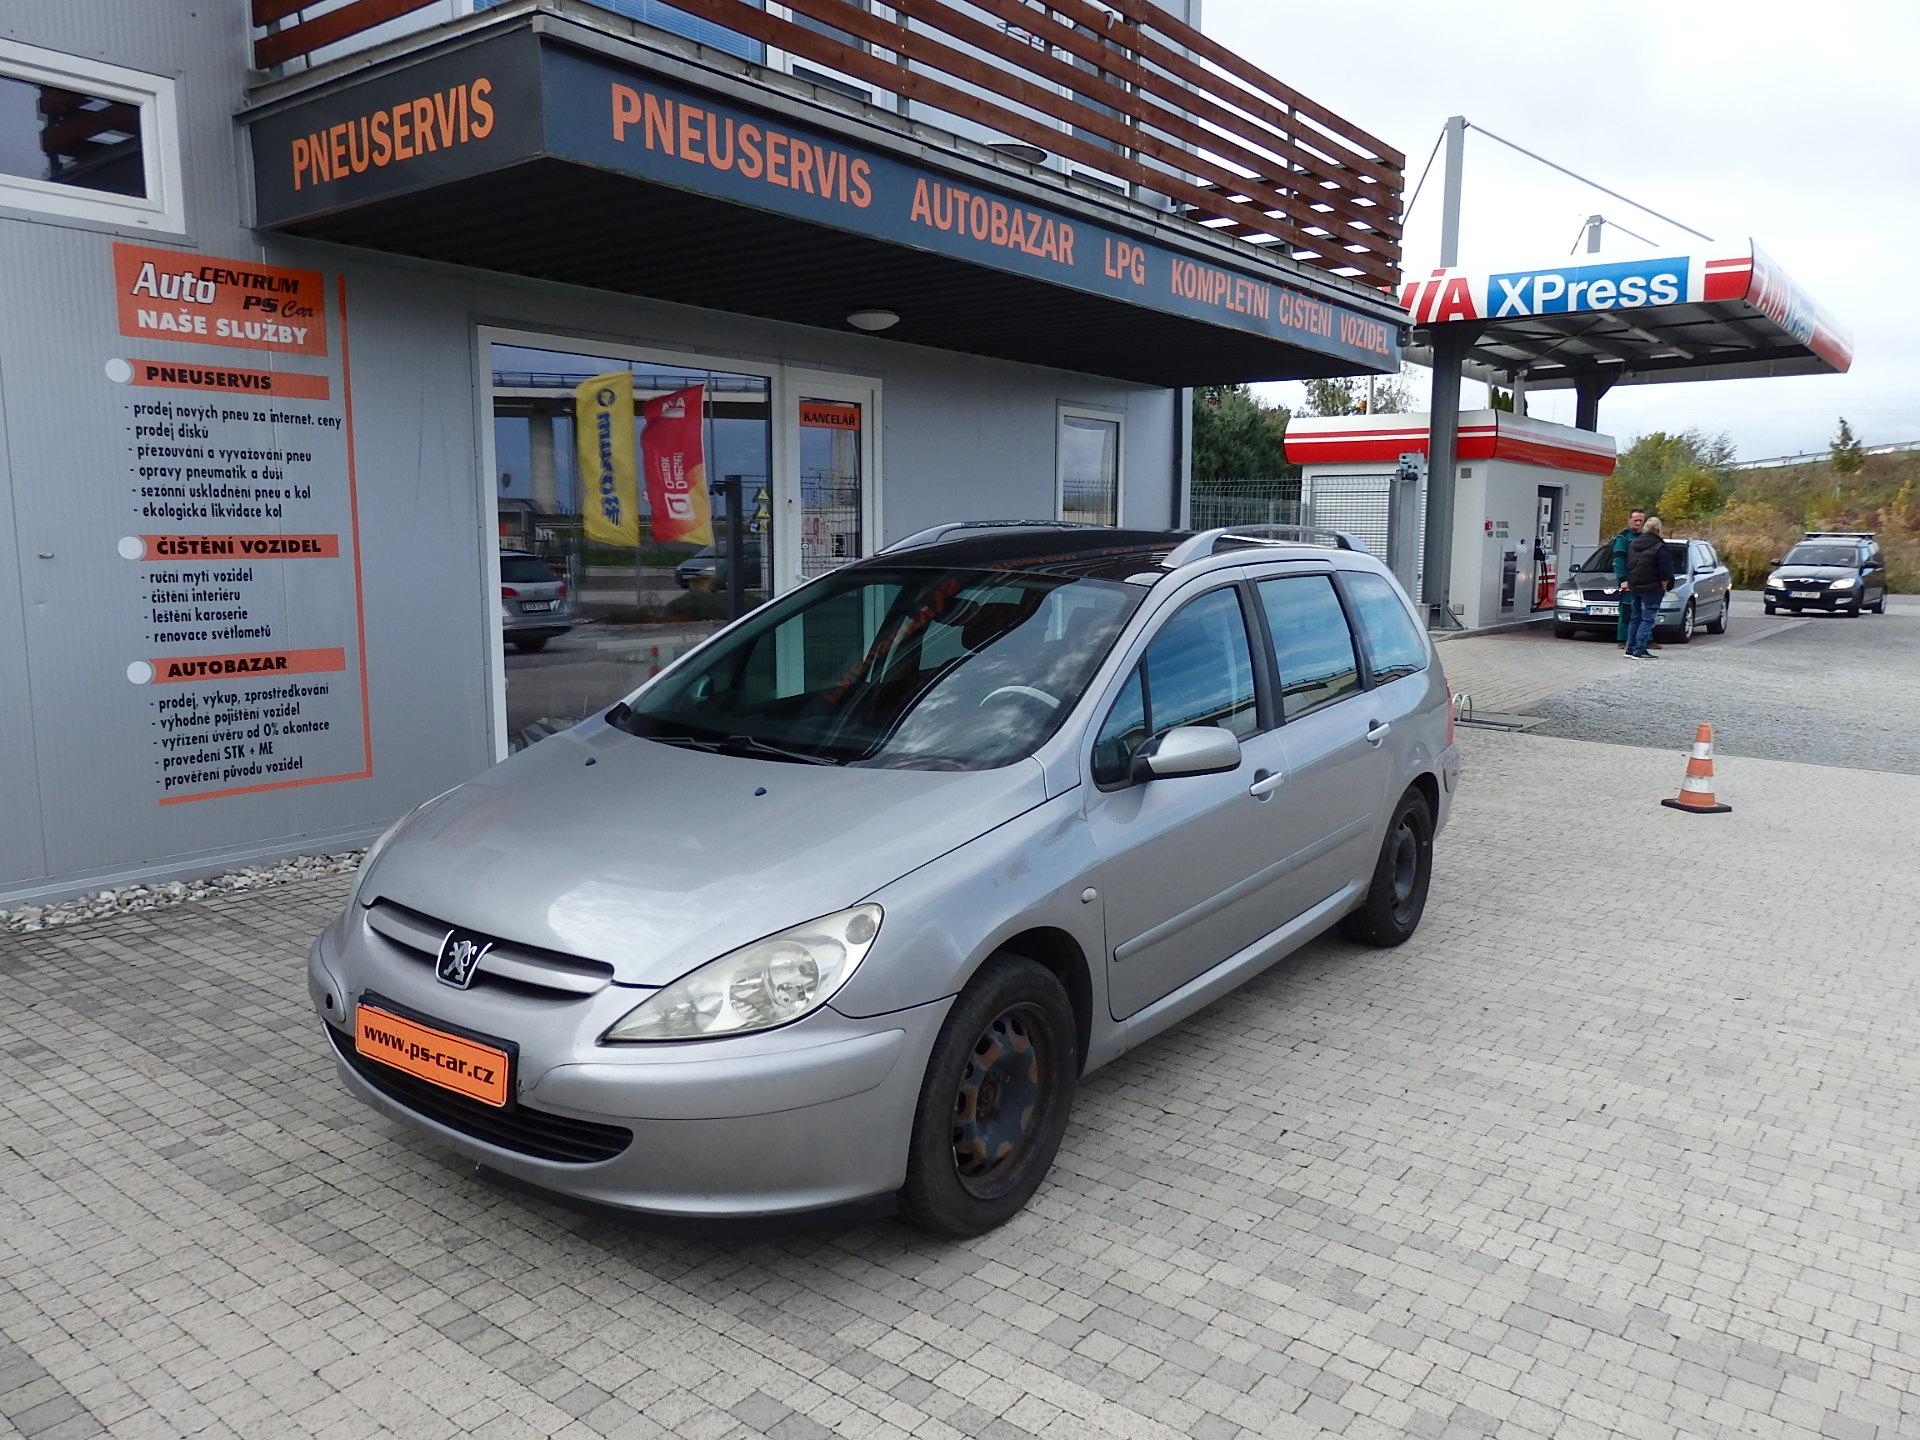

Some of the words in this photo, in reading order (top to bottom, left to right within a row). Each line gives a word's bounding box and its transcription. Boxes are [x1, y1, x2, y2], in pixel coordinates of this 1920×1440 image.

[291, 77, 494, 191] PNEUSERVIS
[611, 82, 872, 209] PNEUSERVIS
[910, 178, 1075, 266] AUTOBAZAR
[1104, 238, 1145, 285] LPG
[1171, 258, 1271, 320] KOMPLETNÍ
[1340, 312, 1389, 355] VOZIDEL
[131, 261, 217, 305] Auto
[200, 266, 299, 294] CENTRUM
[243, 296, 278, 312] PS
[281, 301, 314, 318] Car
[1496, 273, 1680, 318] XPress
[137, 307, 207, 335] NAŠE
[217, 318, 308, 345] SLUŽBY
[146, 366, 272, 390] PNEUSERVIS
[133, 402, 174, 420] prodej
[176, 404, 218, 421] nových
[222, 409, 249, 422] pneu
[253, 412, 266, 422] za
[270, 408, 315, 425] internet.
[318, 416, 342, 430] ceny
[135, 422, 175, 441] prodej
[137, 444, 204, 460] přezouvání
[207, 449, 215, 457] a
[218, 447, 283, 462] vyvažování
[286, 452, 312, 464] pneu
[139, 466, 182, 481] opravy
[186, 465, 247, 481] pneumatik
[251, 470, 258, 479] a
[141, 484, 186, 497] sezónní
[189, 483, 251, 498] uskladnění
[255, 488, 281, 501] pneu
[284, 489, 291, 499] a
[295, 485, 311, 499] kol
[142, 502, 208, 521] ekologická
[211, 503, 262, 518] likvidace
[265, 503, 283, 518] kol
[157, 536, 234, 555] ČIŠTĚNÍ
[240, 539, 321, 554] VOZIDEL
[149, 569, 179, 583] ruční
[213, 567, 253, 582] vozidel
[151, 589, 189, 603] čištění
[192, 587, 241, 602] interiéru
[152, 608, 192, 623] leštění
[195, 606, 248, 621] karoserie
[153, 630, 208, 643] renovace
[211, 624, 271, 640] světlometů
[167, 656, 287, 677] AUTOBAZAR
[158, 692, 199, 713] prodej,
[203, 690, 241, 708] výkup,
[160, 711, 211, 732] výhodné
[214, 707, 259, 727] pojištění
[262, 702, 301, 718] vozidel
[161, 731, 209, 751] vyřízení
[246, 724, 260, 738] od
[263, 722, 279, 736] 0%
[282, 720, 330, 735] akontace
[163, 749, 221, 771] provedení
[223, 744, 246, 760] STK
[249, 747, 255, 756] +
[258, 741, 274, 756] ME
[164, 767, 220, 790] prověření
[223, 761, 262, 782] původu
[265, 755, 303, 773] vozidel
[364, 1025, 495, 1085] www.ps-car.cz
